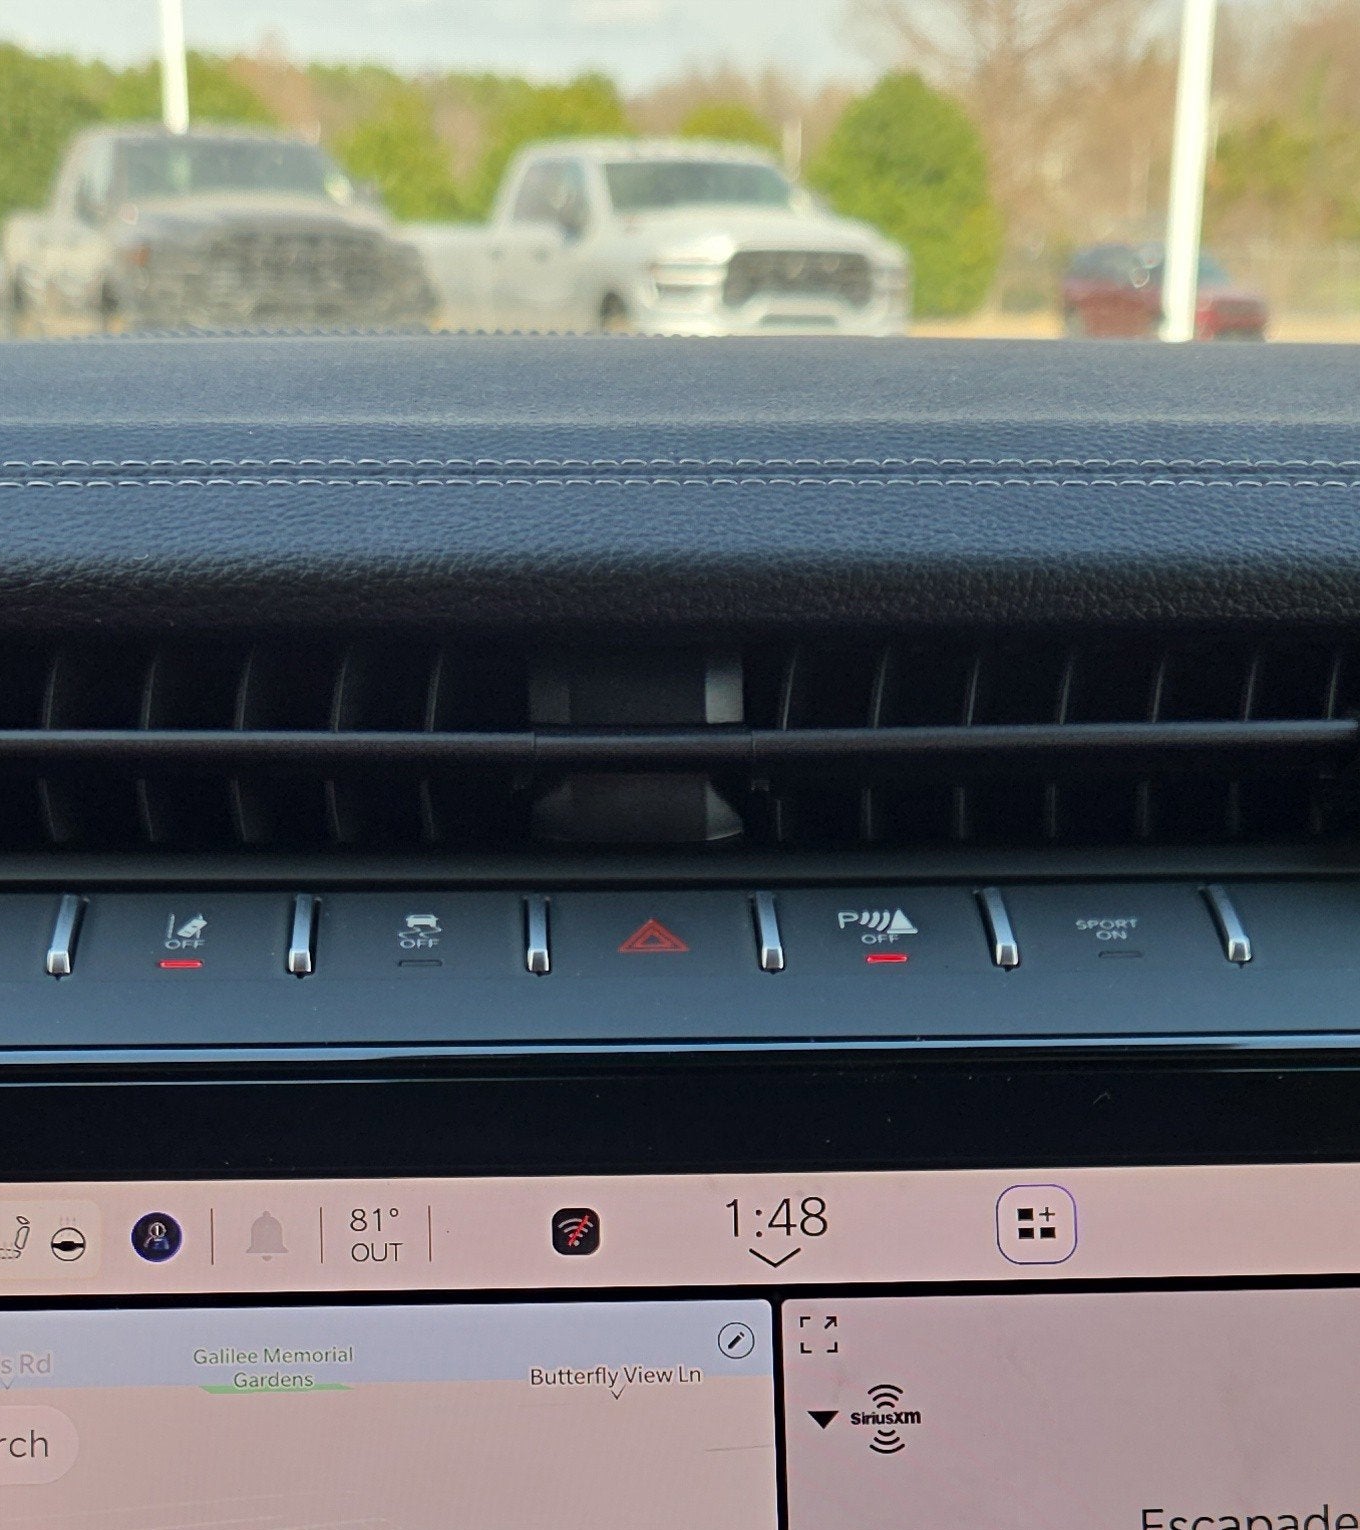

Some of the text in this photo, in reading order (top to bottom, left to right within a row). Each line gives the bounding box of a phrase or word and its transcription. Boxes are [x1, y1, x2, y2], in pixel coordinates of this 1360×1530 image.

[838, 911, 858, 930] P
[1075, 918, 1139, 932] SPORT
[164, 938, 205, 950] OFF
[399, 936, 441, 948] OFF
[861, 933, 899, 945] OFF
[1096, 929, 1127, 941] ON
[349, 1207, 400, 1233] 81°
[725, 1197, 829, 1239] 1:48
[350, 1242, 404, 1263] OUT
[18, 1350, 52, 1375] Rd
[192, 1344, 354, 1366] Galilee Memorial
[233, 1369, 315, 1390] Gardens
[530, 1364, 702, 1388] Butterfly View Ln
